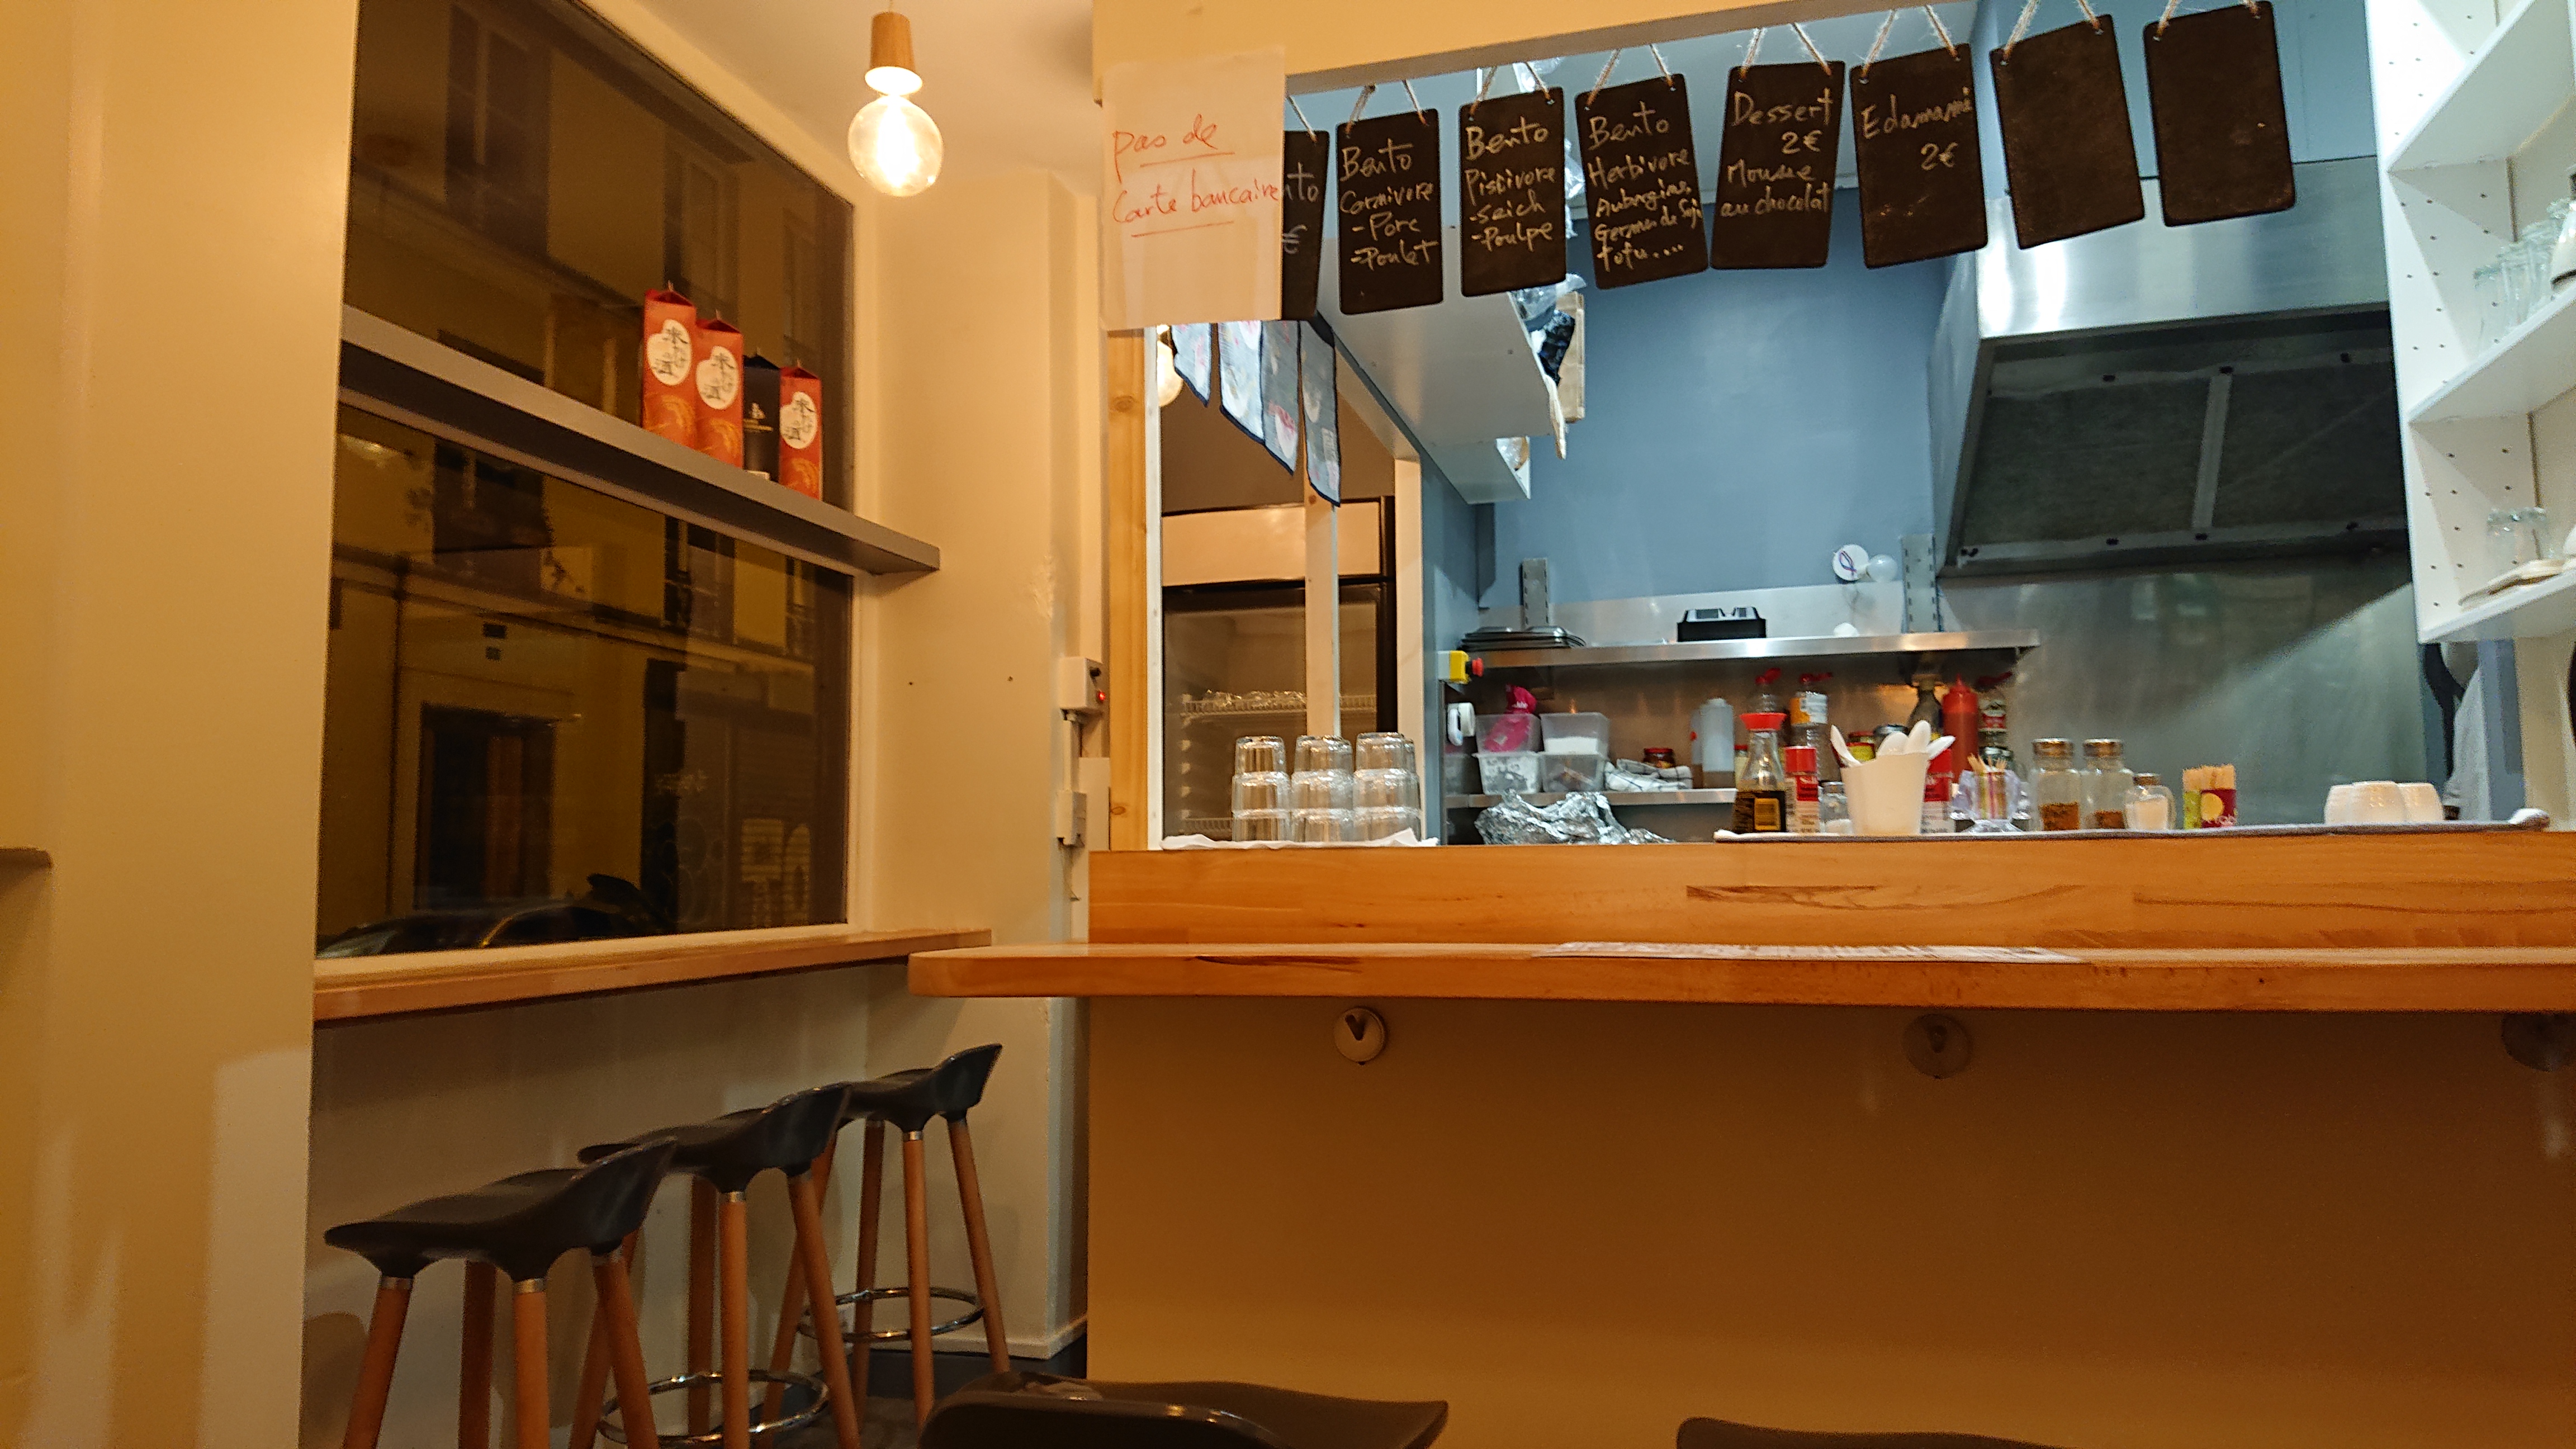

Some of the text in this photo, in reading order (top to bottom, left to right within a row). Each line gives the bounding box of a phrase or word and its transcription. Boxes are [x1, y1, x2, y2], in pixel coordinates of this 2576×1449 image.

[1588, 101, 1669, 151] Bento
[1731, 87, 1834, 126] Dessert
[1182, 113, 1218, 150] de
[1465, 116, 1549, 160] Bento
[1781, 130, 1823, 154] 2€
[1339, 138, 1414, 182] Bento
[1587, 148, 1691, 191] Herbivore
[1920, 142, 1958, 171] 2€
[1191, 168, 1279, 213] bancaire
[1720, 201, 1750, 218] au
